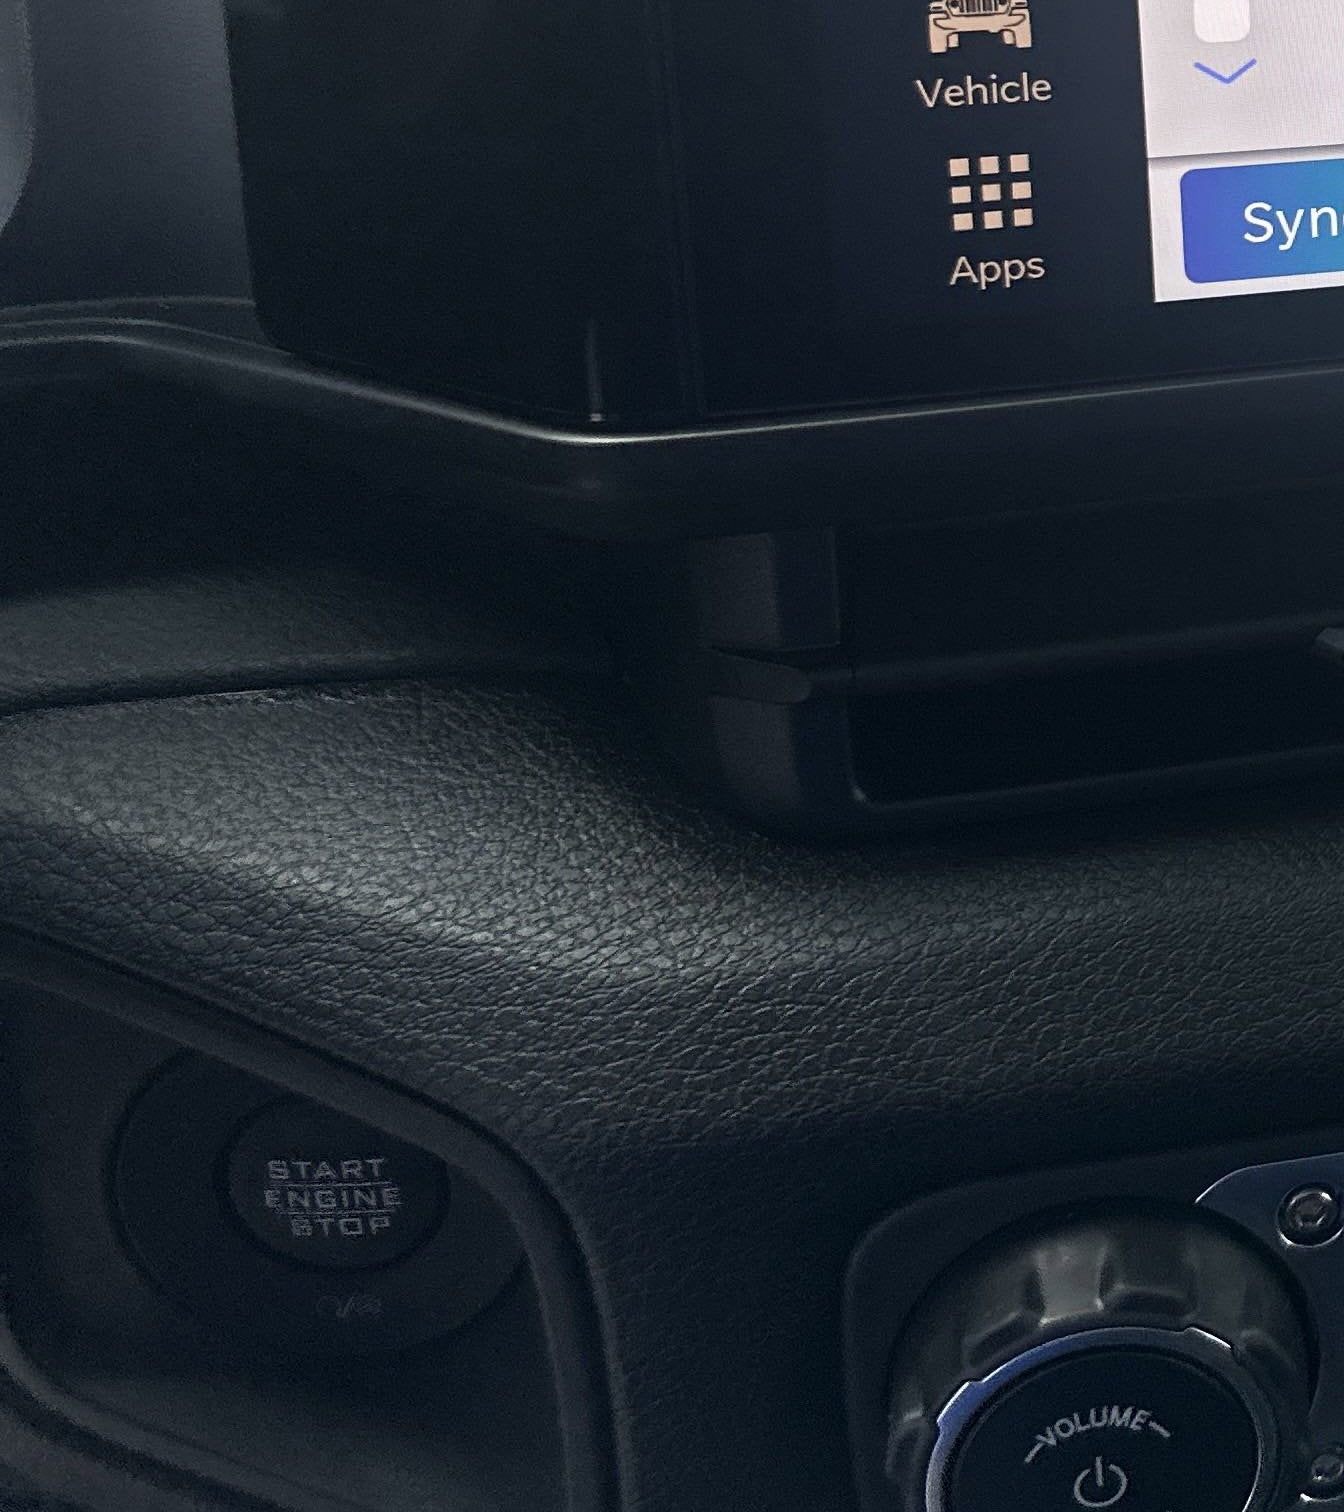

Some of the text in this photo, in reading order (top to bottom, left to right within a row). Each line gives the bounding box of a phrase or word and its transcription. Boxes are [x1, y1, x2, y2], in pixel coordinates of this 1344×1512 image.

[914, 72, 1053, 109] Vehicle
[949, 255, 1046, 291] Apps
[266, 1157, 386, 1180] START
[263, 1187, 402, 1209] ENGINE
[290, 1216, 391, 1238] STOP
[1036, 1406, 1152, 1449] VOLUME
